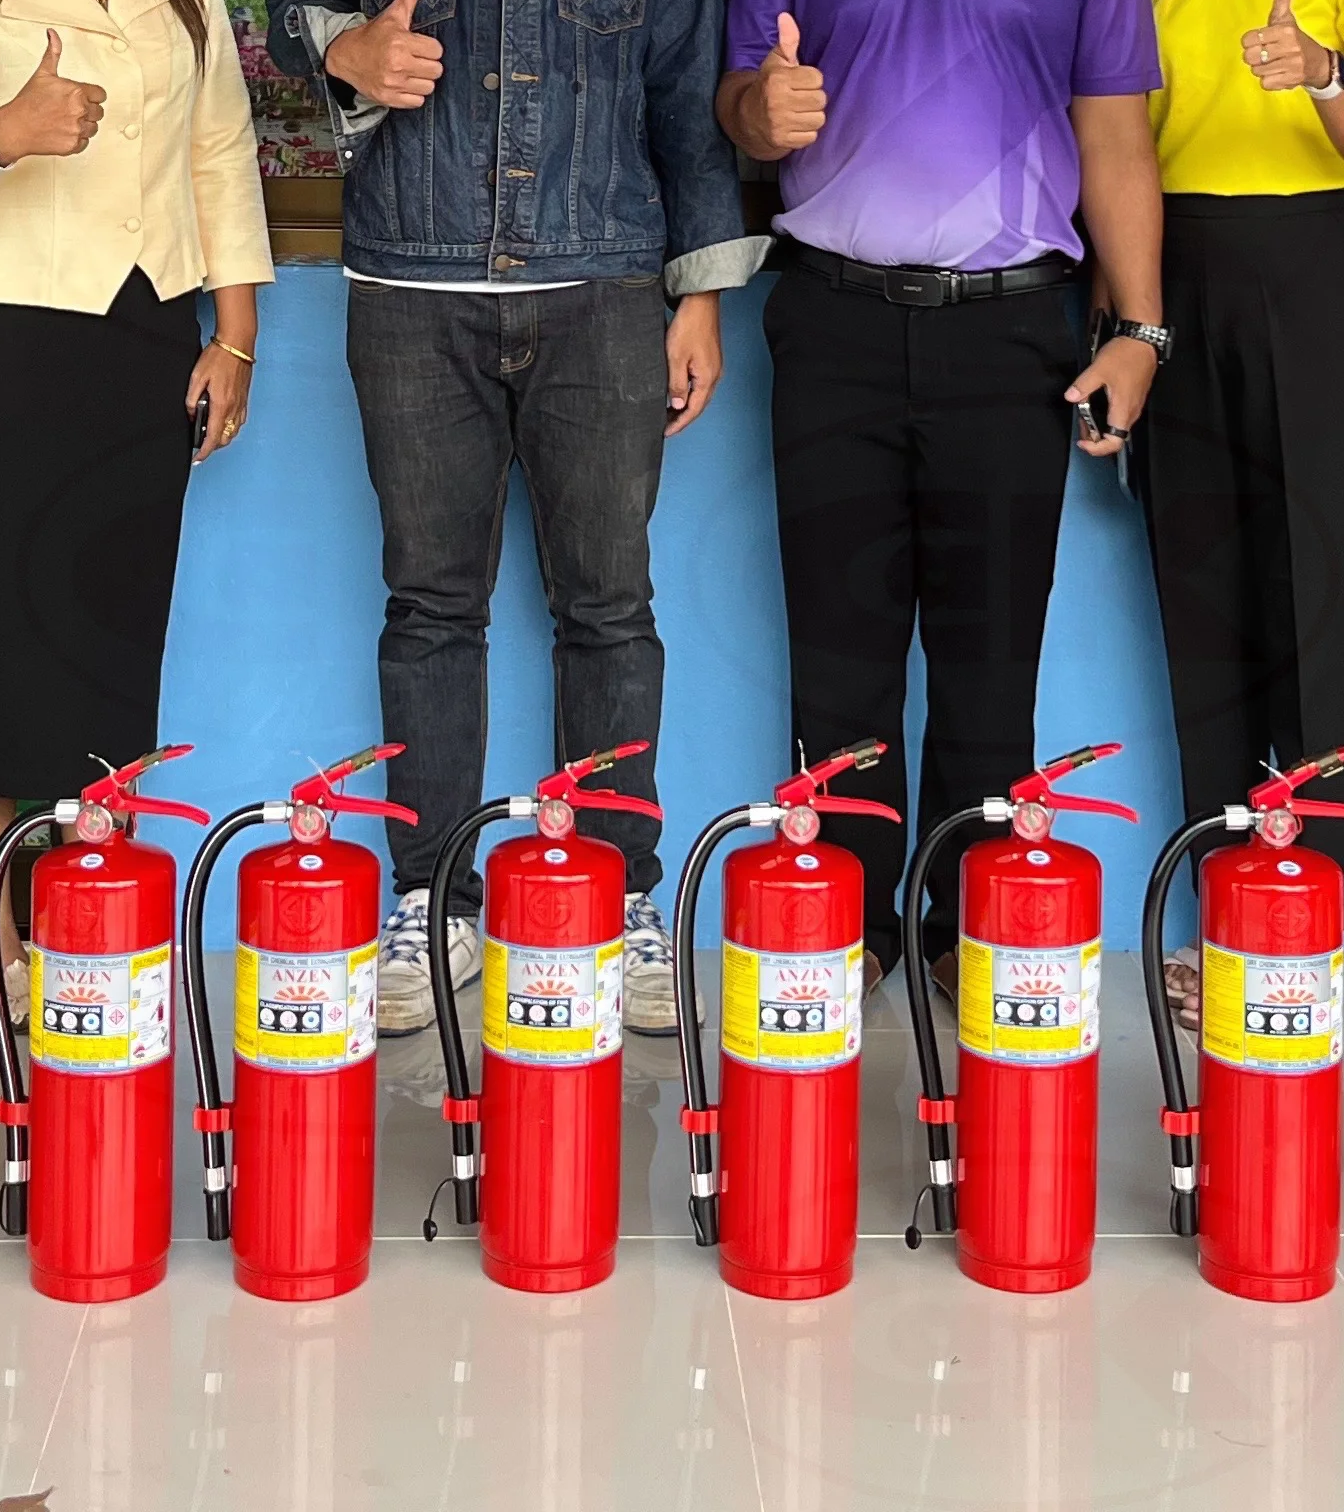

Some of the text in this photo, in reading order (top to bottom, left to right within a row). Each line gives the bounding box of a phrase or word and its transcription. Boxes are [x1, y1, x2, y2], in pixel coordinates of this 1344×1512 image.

[273, 969, 332, 982] ANZEN
[523, 963, 580, 976] ANZEN
[776, 967, 832, 981] ANZEN
[1008, 963, 1066, 976] ANZEN
[55, 970, 112, 985] ANZEN
[1261, 972, 1319, 985] ANZEN
